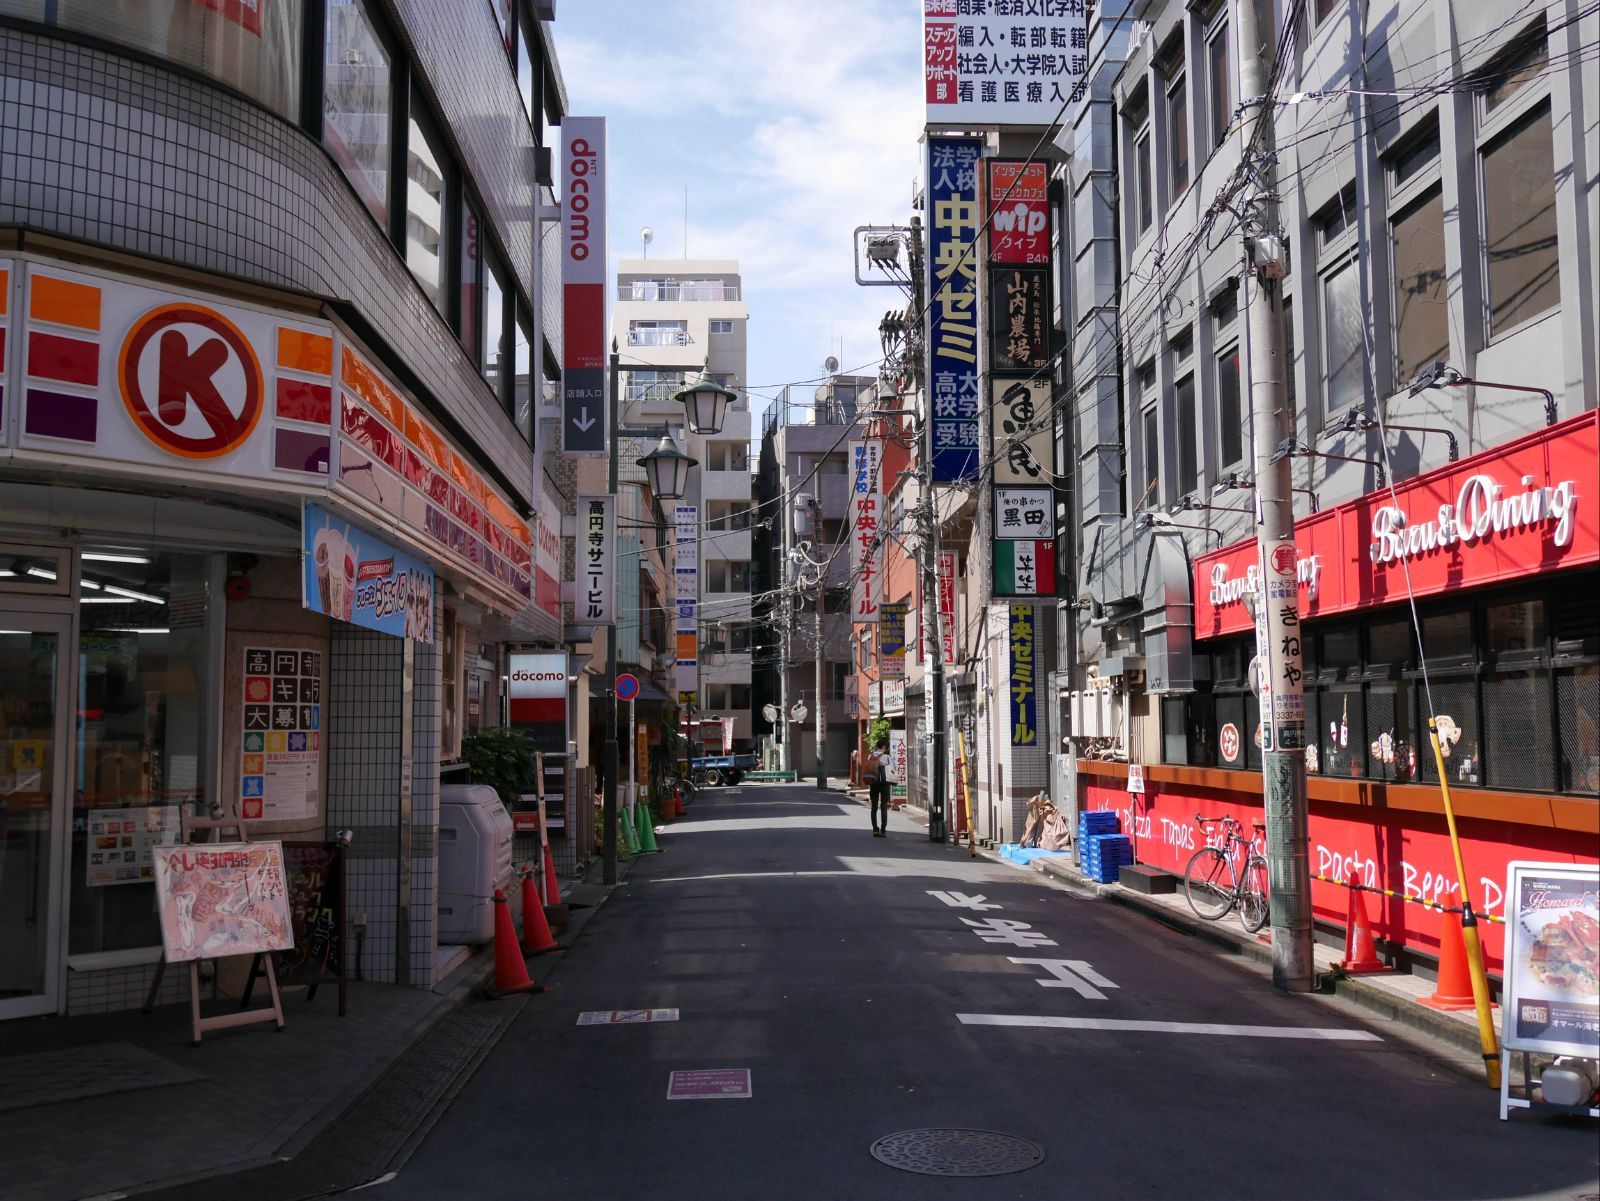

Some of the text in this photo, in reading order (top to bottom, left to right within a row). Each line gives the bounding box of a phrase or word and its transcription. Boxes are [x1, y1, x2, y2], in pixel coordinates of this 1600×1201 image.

[926, 24, 956, 43] ステップ
[958, 25, 1086, 49] 編入・転部転籍
[927, 45, 954, 62] アップ
[958, 52, 1087, 76] 社会人・大学院入試
[926, 65, 957, 80] サポート
[936, 82, 947, 101] 部
[958, 80, 1086, 103] 看護医療入試
[993, 166, 1044, 177] インターネット
[570, 138, 596, 261] docomo
[993, 187, 1046, 198] コミックカフェ
[993, 203, 1047, 236] wip
[1003, 238, 1039, 250] ワイプ
[992, 253, 1002, 263] 4F
[1026, 253, 1049, 264] 24h
[1007, 271, 1031, 363] 山内農場
[1034, 359, 1047, 368] 3F
[158, 328, 240, 440] K
[935, 370, 957, 417] 高校
[1034, 380, 1049, 389] 2F
[936, 422, 979, 446] 受験
[998, 491, 1008, 499] 1F
[1003, 507, 1045, 528] 黒田
[1043, 542, 1053, 550] 1F
[587, 500, 604, 618] 高円寺サニービル
[1280, 605, 1301, 687] きねや
[512, 670, 564, 682] docomo
[1160, 817, 1195, 861] Tapas
[1317, 845, 1376, 889] Pasta
[1400, 861, 1460, 913] Beer
